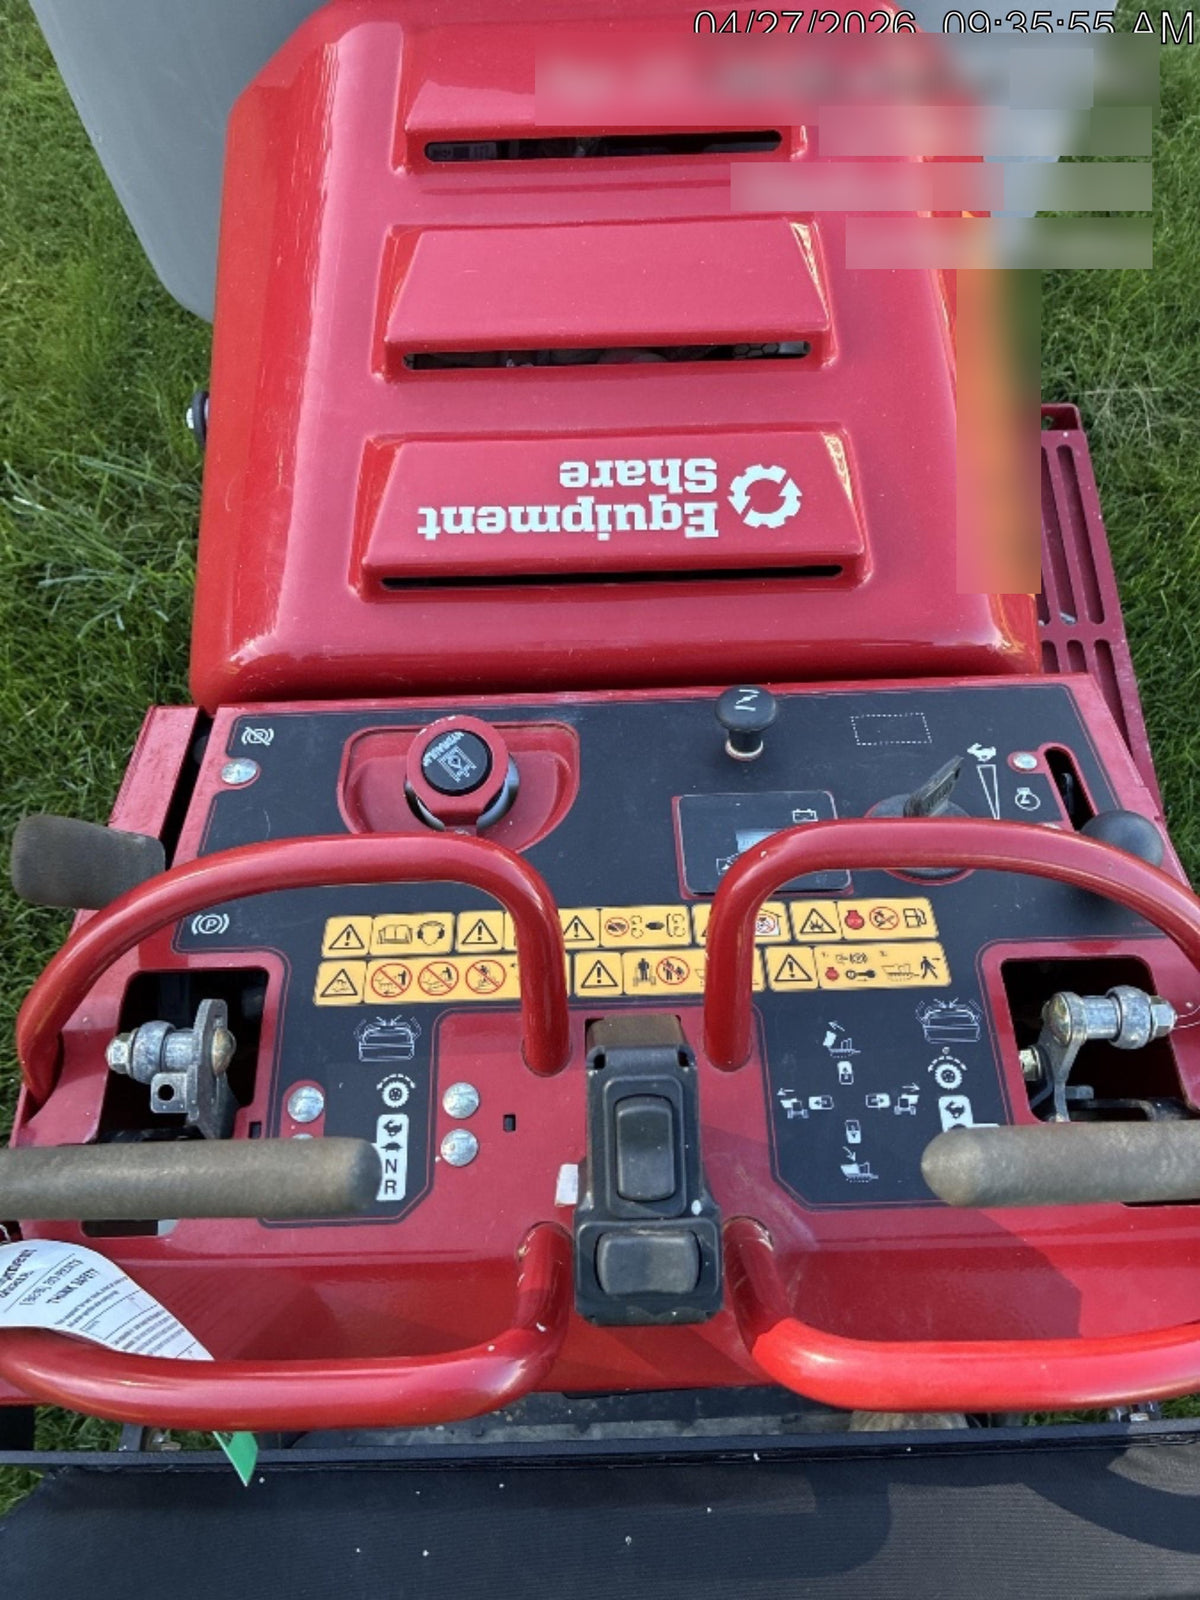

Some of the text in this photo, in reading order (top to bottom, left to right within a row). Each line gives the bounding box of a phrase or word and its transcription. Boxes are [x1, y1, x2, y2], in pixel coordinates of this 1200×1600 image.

[559, 457, 717, 494] Share
[417, 495, 719, 541] Equipment
[385, 1158, 398, 1174] N
[384, 1179, 398, 1195] R
